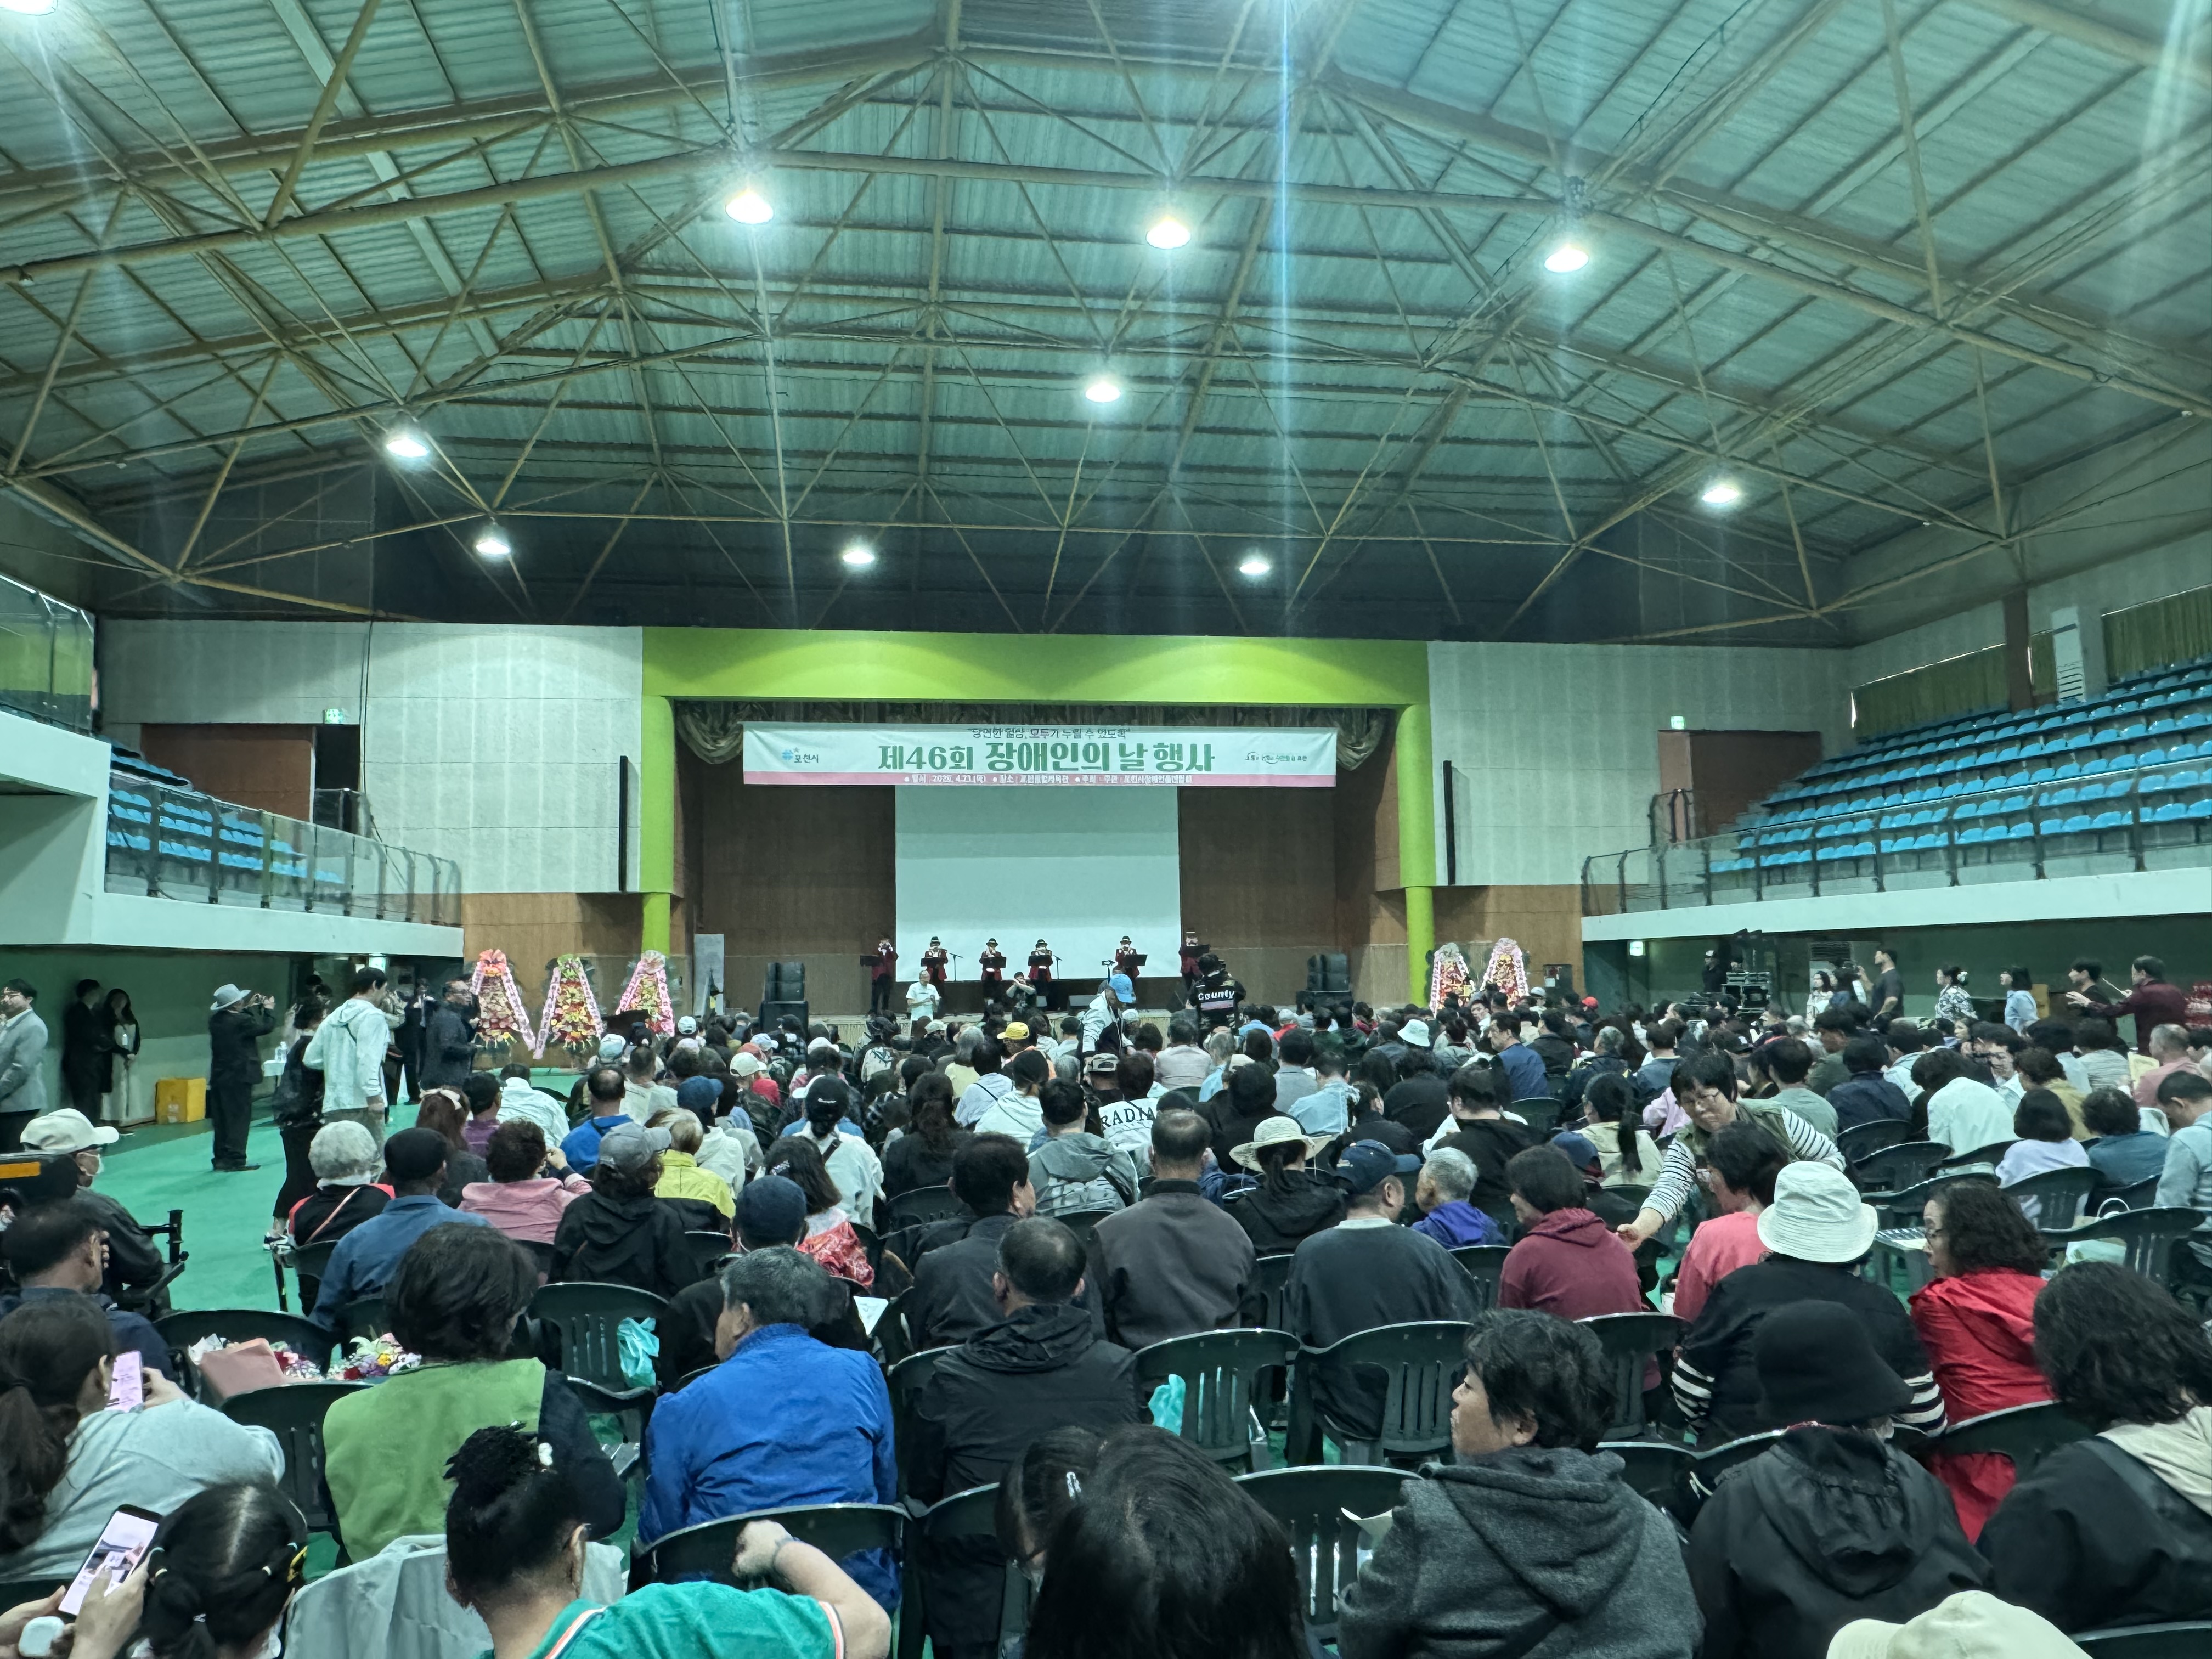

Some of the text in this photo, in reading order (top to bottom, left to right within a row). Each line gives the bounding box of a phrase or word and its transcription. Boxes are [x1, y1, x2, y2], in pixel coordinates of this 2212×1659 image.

[1085, 728, 1094, 740] 수
[794, 754, 819, 763] 포천시
[878, 745, 973, 770] 제46회
[985, 742, 1110, 772] 장애인의
[1118, 743, 1148, 771] 날
[1153, 742, 1215, 772] 행사
[1198, 990, 1235, 1001] County
